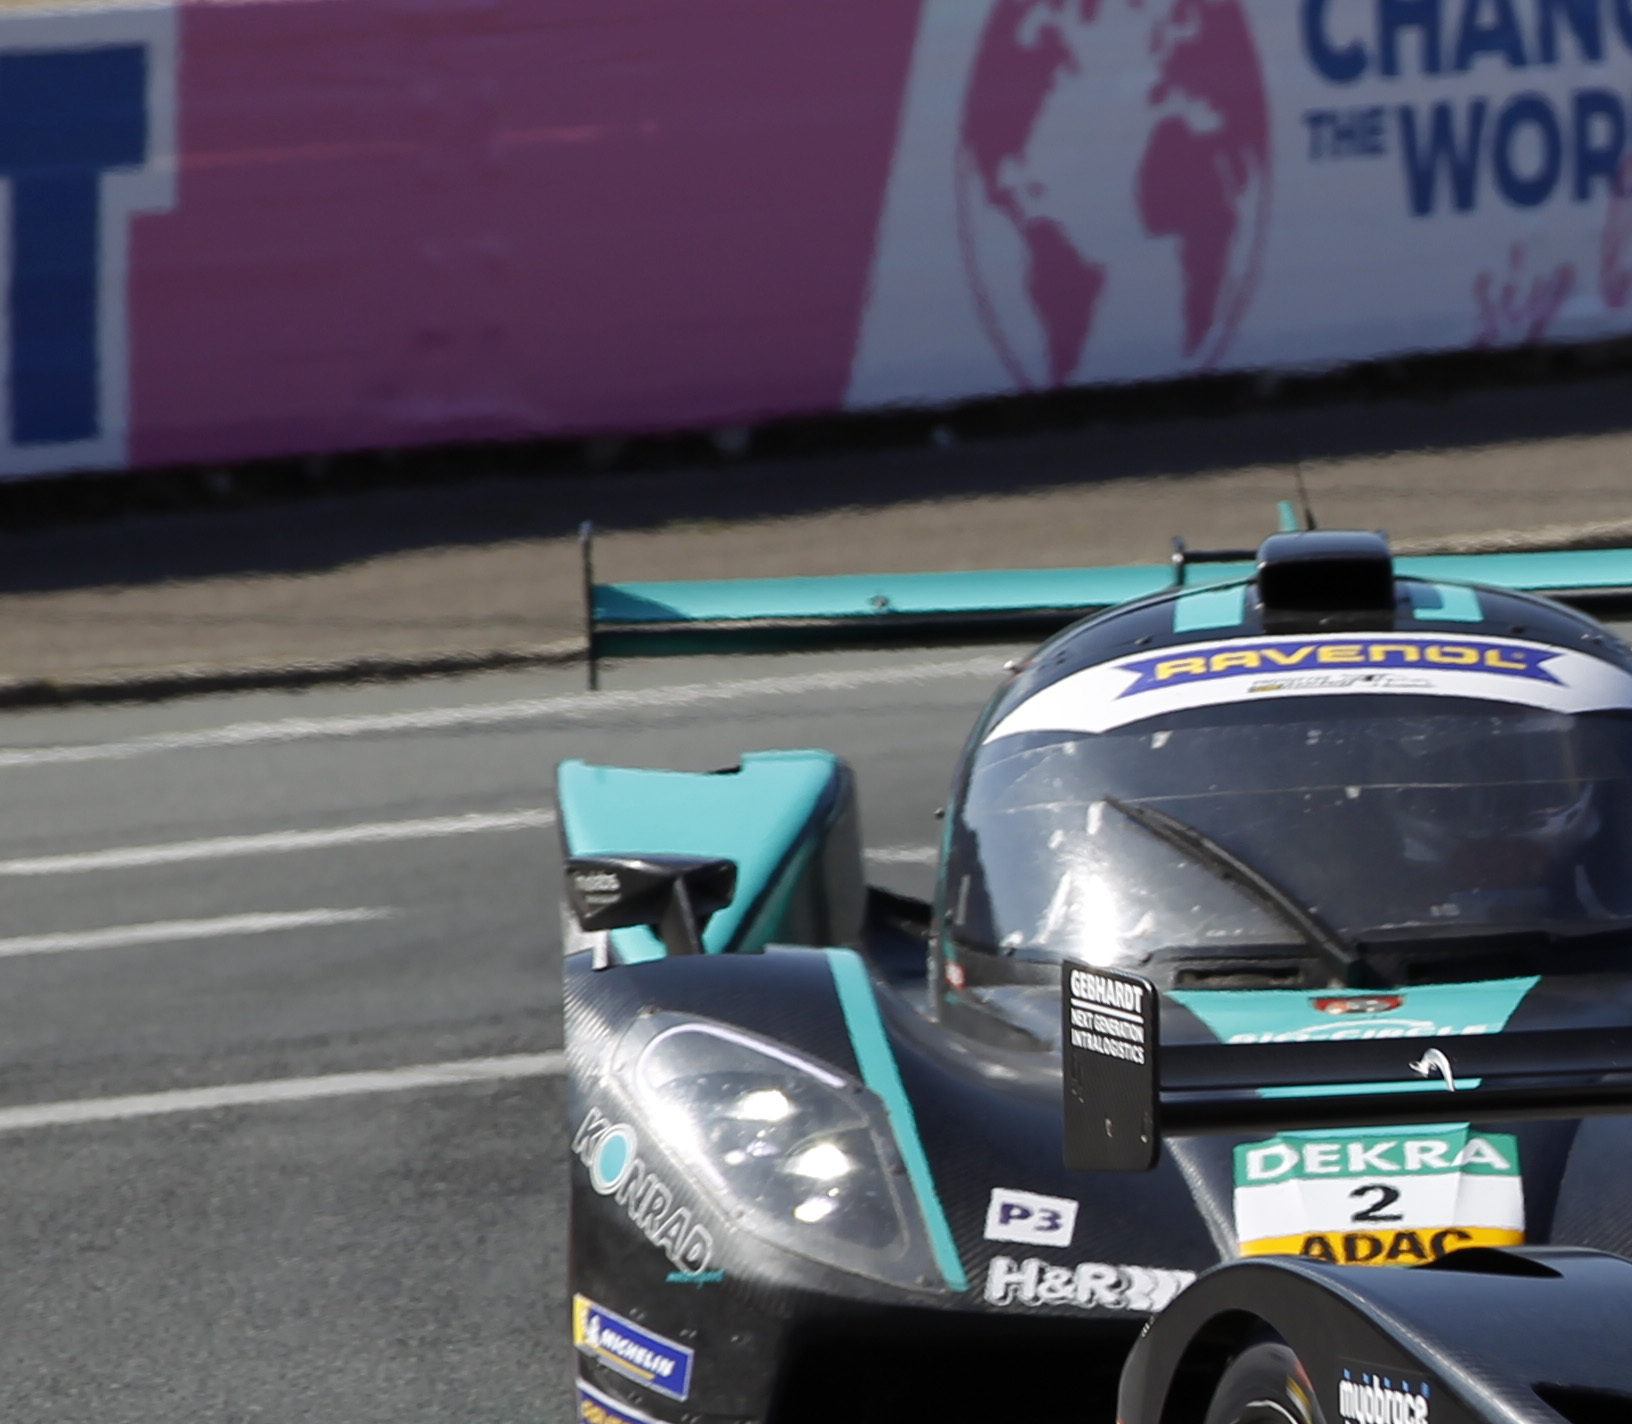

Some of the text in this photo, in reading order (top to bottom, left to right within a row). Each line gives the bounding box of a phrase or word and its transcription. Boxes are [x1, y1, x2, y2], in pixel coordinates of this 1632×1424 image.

[1302, 107, 1386, 163] THE
[1154, 640, 1528, 682] RAVENOL
[1070, 970, 1143, 1012] GEBHARDT
[1071, 1007, 1144, 1044] NEXT GENERATION
[1071, 1027, 1144, 1065] INTRALOGISTICS
[1246, 1136, 1511, 1181] DEKRA
[571, 1106, 714, 1274] KONRAD
[1349, 1183, 1404, 1223] 2
[998, 1201, 1064, 1233] P3
[1301, 1228, 1473, 1265] ADAC
[600, 1328, 676, 1378] MICHELIN
